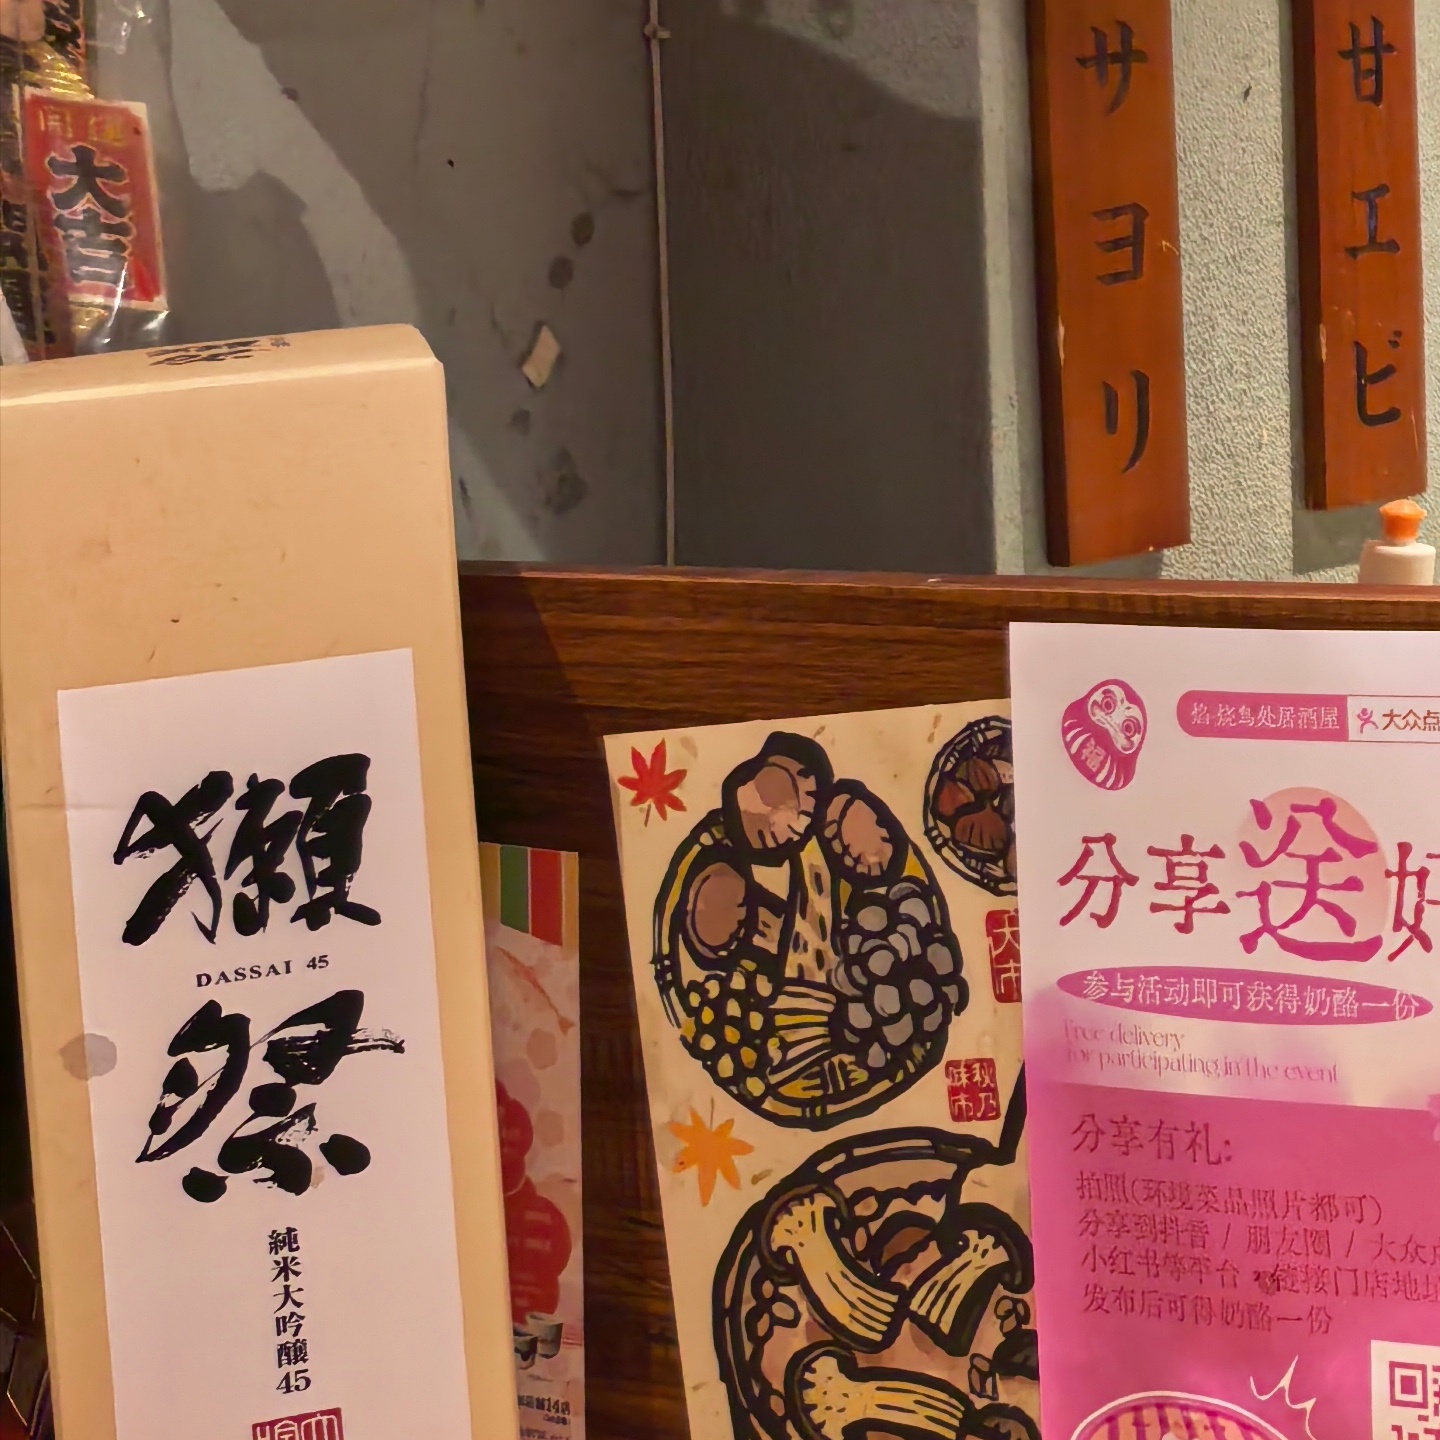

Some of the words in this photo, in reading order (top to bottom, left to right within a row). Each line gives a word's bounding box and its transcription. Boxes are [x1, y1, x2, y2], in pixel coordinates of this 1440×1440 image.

[1338, 15, 1402, 427] 甘エビ
[1076, 19, 1151, 474] サヨリ
[196, 959, 292, 988] DASSAI
[306, 954, 330, 970] 45
[1083, 970, 1420, 1020] 参与活动即可获得奶酪一份
[1110, 1022, 1186, 1051] delivery
[1284, 1063, 1339, 1084] event
